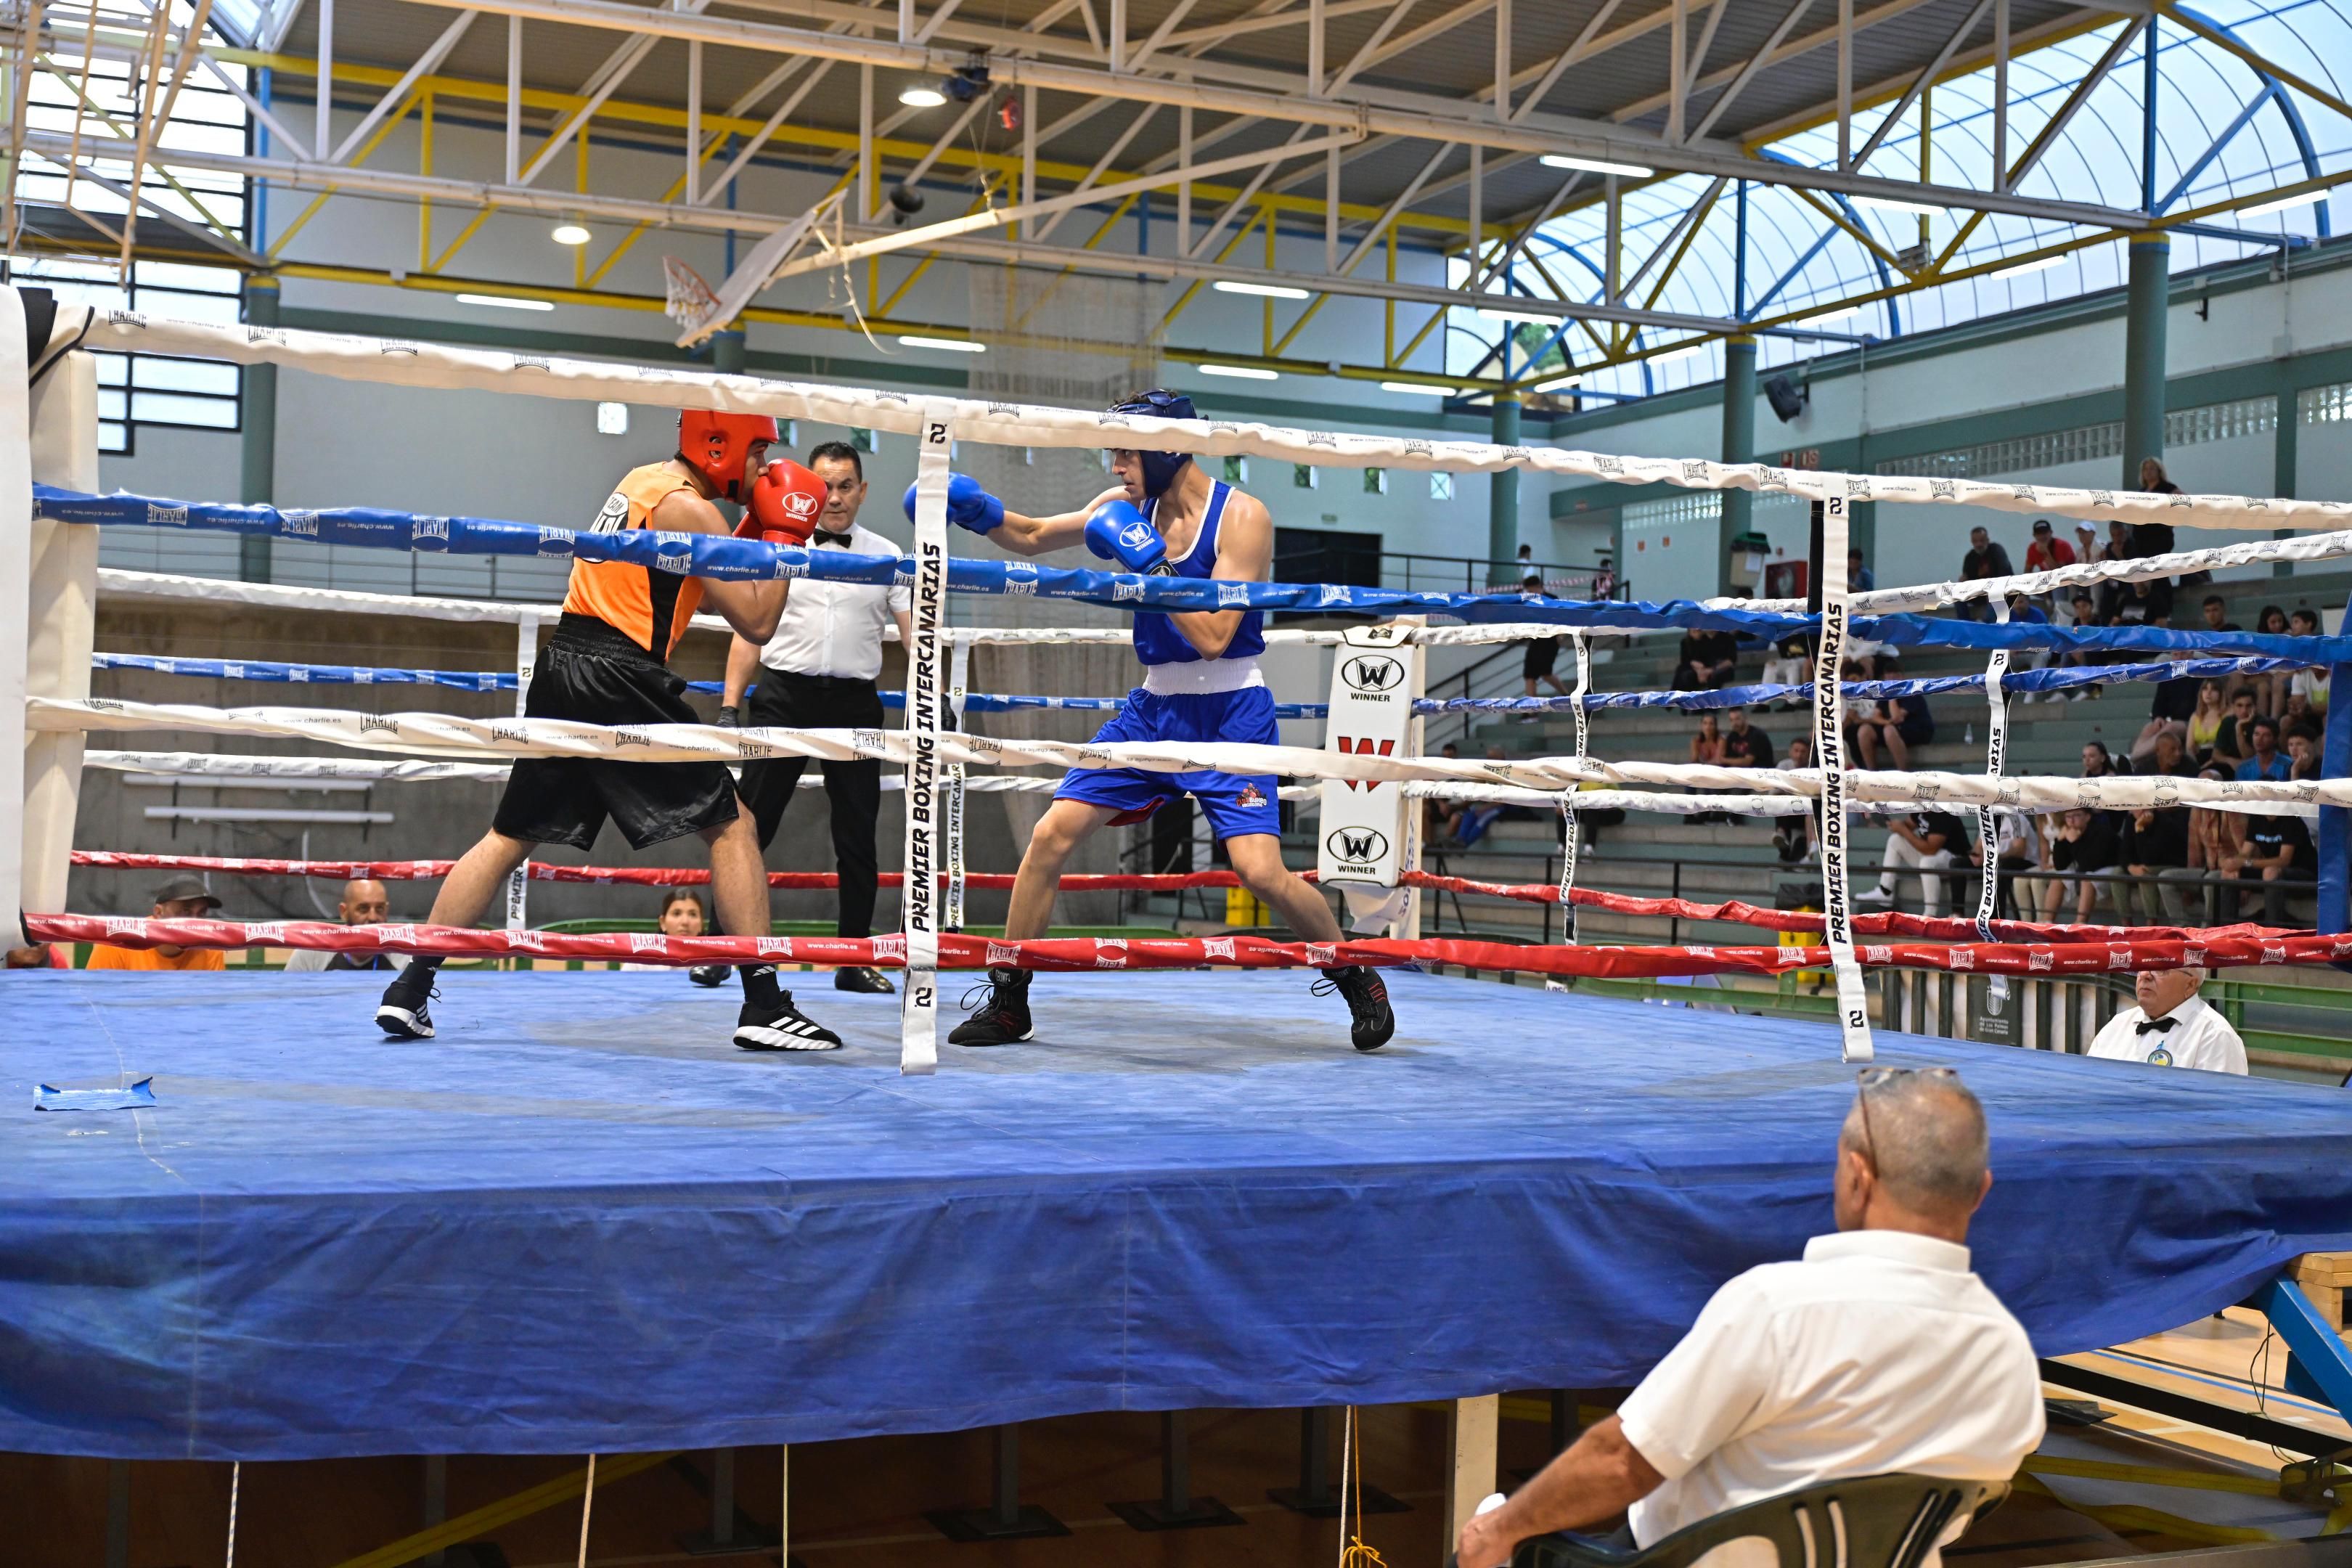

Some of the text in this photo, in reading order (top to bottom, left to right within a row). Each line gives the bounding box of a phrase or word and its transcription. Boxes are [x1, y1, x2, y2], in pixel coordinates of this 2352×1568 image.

[988, 401, 1020, 418] CHARLIE
[1404, 438, 1432, 458] CHARLIE
[1593, 455, 1625, 475] CHARLIE
[1683, 460, 1709, 482] CHARLIE
[1760, 465, 1787, 489] CHARLIE
[1846, 478, 1871, 499] HARLIE
[1929, 480, 1955, 499] CHARLIE
[2089, 490, 2114, 507] CHARLIE
[147, 502, 187, 526] CHARLIE
[282, 510, 318, 536] CHARLIE
[785, 512, 808, 523] WINNER
[412, 515, 449, 541] CHARLIE
[538, 525, 575, 545] CHARLIE
[1134, 538, 1155, 552] WINNER
[656, 552, 691, 574] CHARLIE
[707, 564, 759, 573] www.charlie.es
[774, 558, 809, 579] CHARLIE
[894, 568, 915, 587] CHAR
[1004, 578, 1038, 596] CHARLIE
[1112, 581, 1146, 603] CHARLIE
[1217, 582, 1250, 607] CHARLIE
[1320, 584, 1352, 605] CHARLIE
[916, 542, 941, 732] INTERCANARIAS
[1350, 692, 1390, 703] WINNER
[360, 712, 398, 734] CHARLIE
[492, 726, 528, 744] CHARLIE
[616, 730, 651, 748] CHARLIE
[853, 730, 885, 751] CHARLIE
[970, 735, 1002, 754] CHARLIE
[668, 744, 720, 753] www.charlie.es
[739, 741, 772, 759] CHARLIE
[913, 736, 934, 824] BOXING
[1819, 603, 1848, 944] PREMIER BOXING INTERCANARIAS
[1561, 703, 1585, 899] PREMIER BOXING ANARIAS
[951, 764, 961, 928] PREMIER BOXING INTERCANAR
[1338, 865, 1376, 875] WINNER
[1983, 851, 1995, 908] BOXING
[912, 828, 931, 933] PREMIER
[511, 870, 523, 920] PREMIER
[107, 917, 147, 939] CHARLIE
[245, 923, 285, 943] CHARLIE
[377, 924, 416, 946] CHARLIE
[505, 930, 544, 950] CHARLIE
[560, 935, 614, 944] www.charlie.es
[629, 934, 667, 954] CHARLIE
[756, 936, 792, 957] CHARLIE
[873, 938, 906, 961] CHARLIE
[1201, 937, 1235, 960] CHARLIE
[986, 941, 1021, 965] CHARLIE
[1306, 943, 1336, 965] CHARLIE
[1777, 947, 1806, 964] CHARLIE
[1865, 945, 1892, 963] CHARLIE
[1949, 949, 1975, 969] CHARLIE
[2029, 951, 2053, 971] CHARLIE
[2108, 949, 2132, 969] CHARLIE
[2184, 948, 2208, 966] CHARLIE
[2260, 945, 2286, 963] CHARLIE
